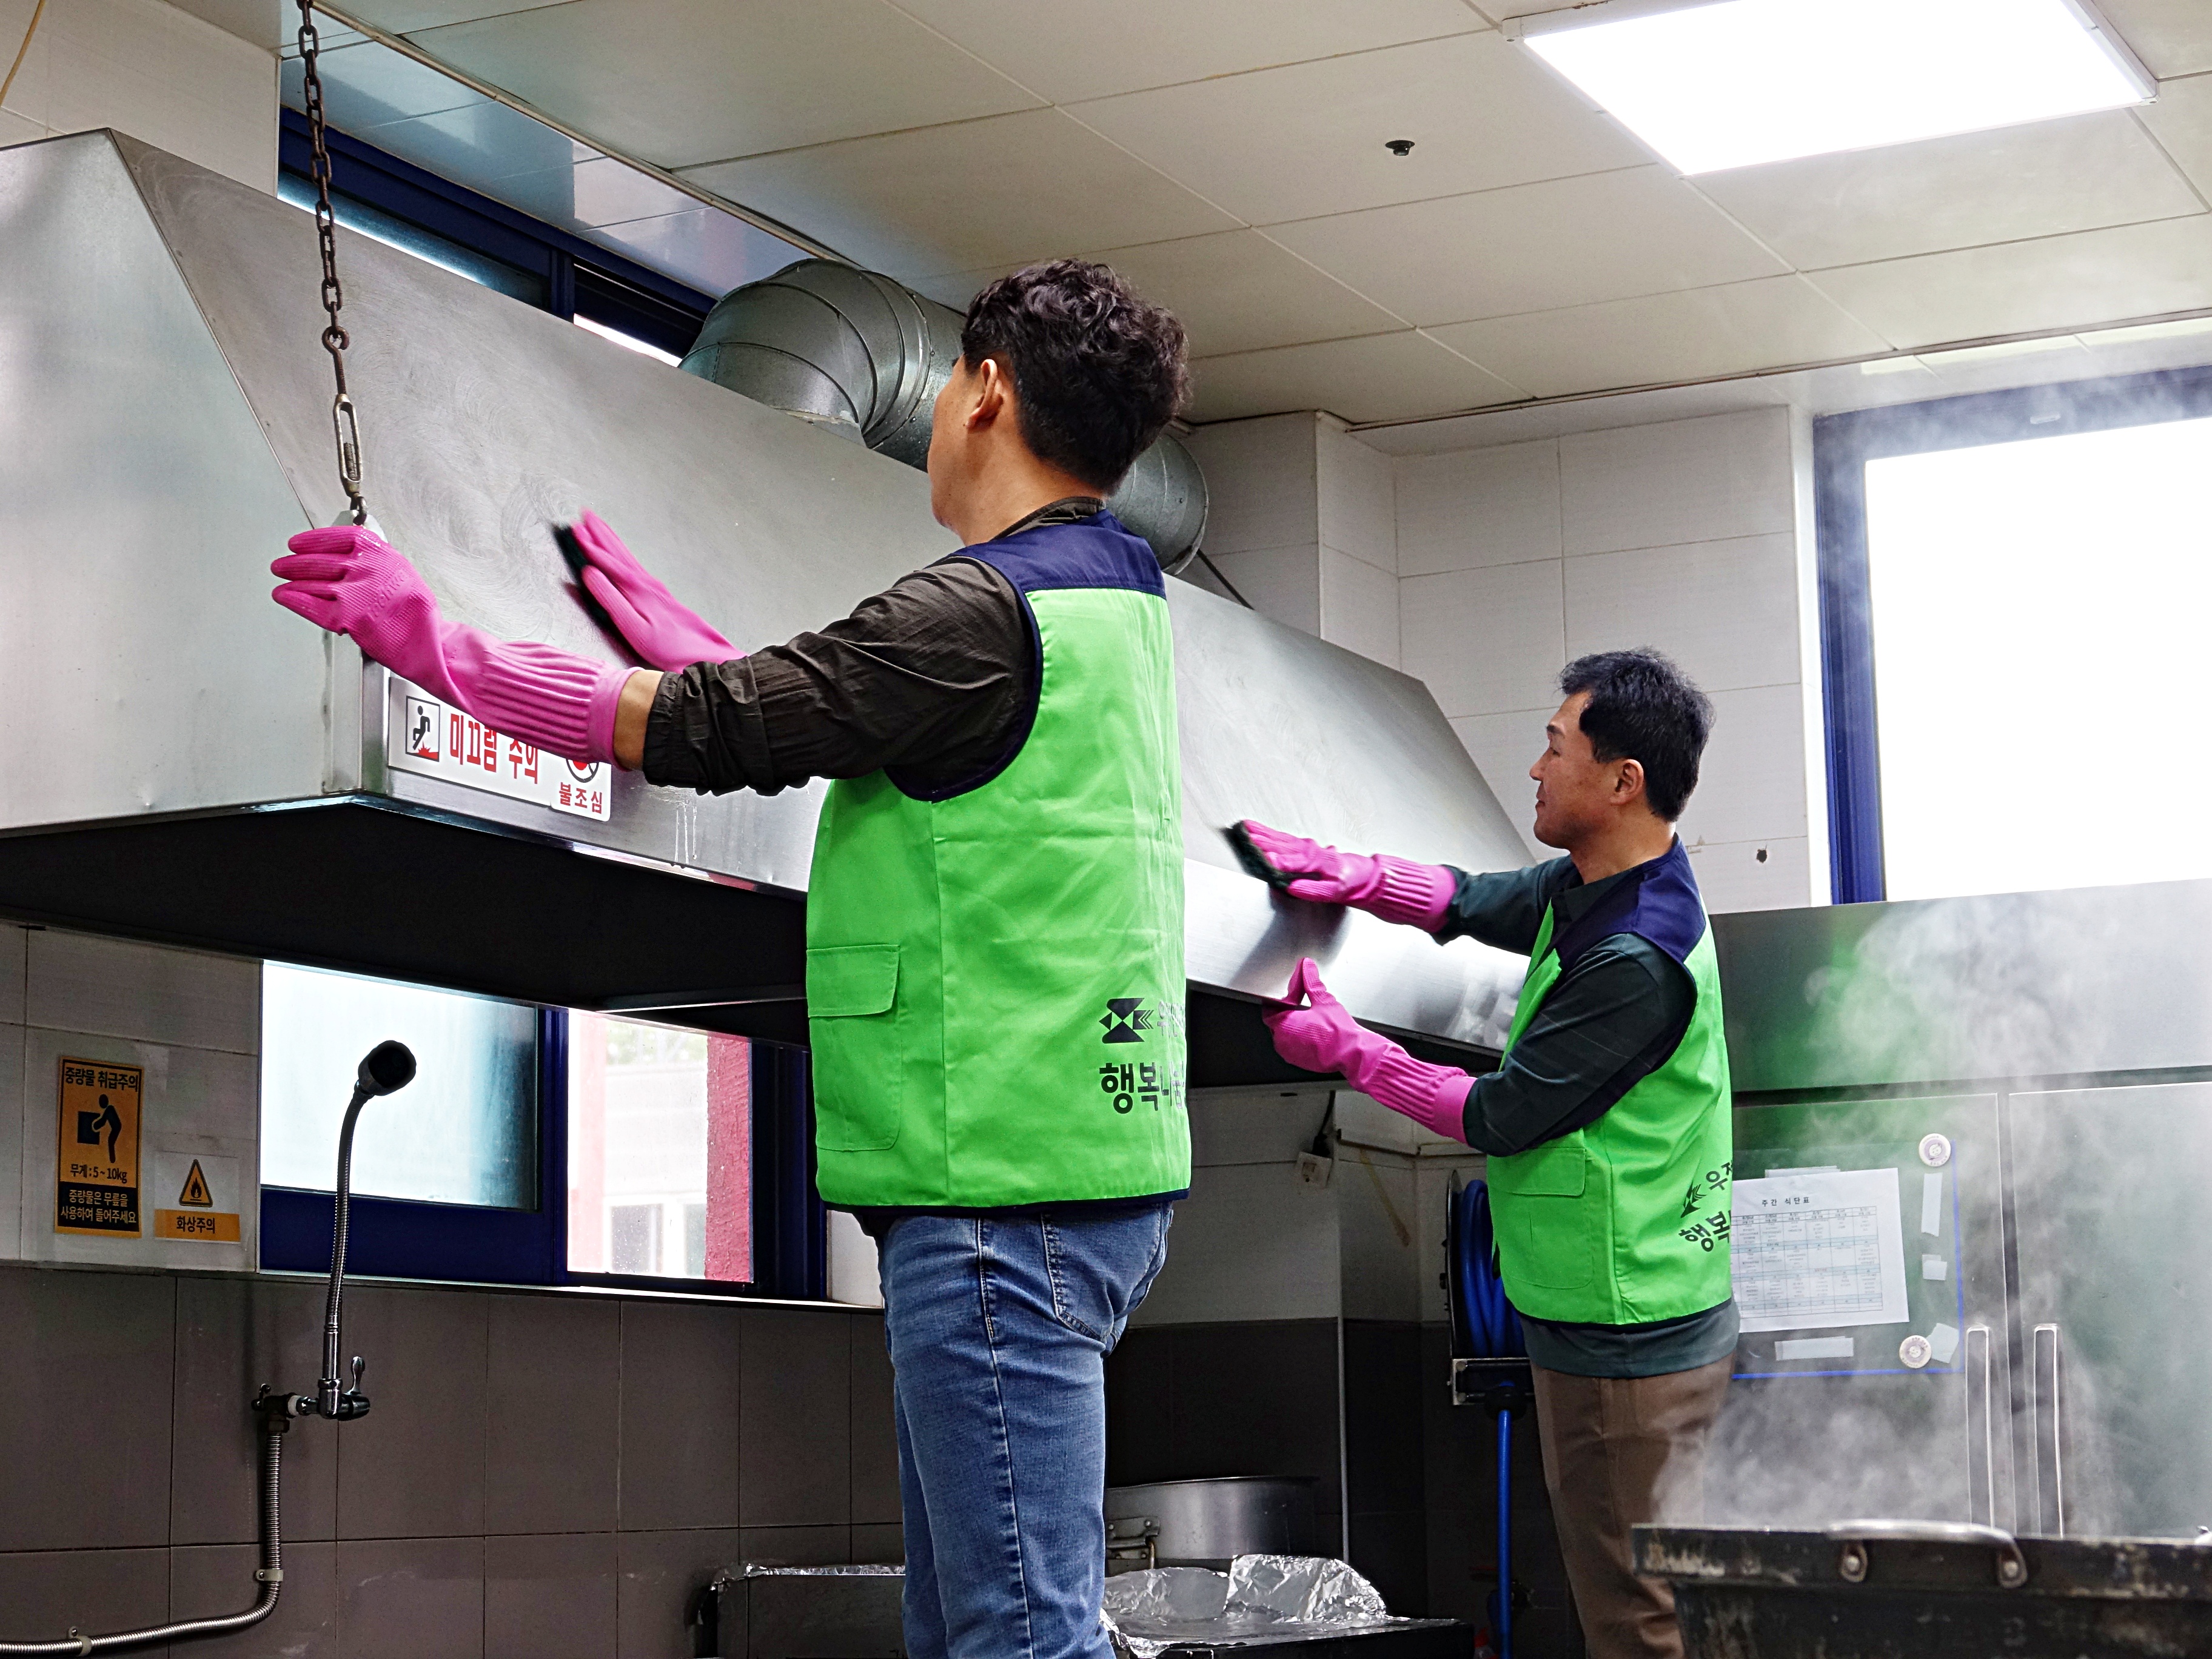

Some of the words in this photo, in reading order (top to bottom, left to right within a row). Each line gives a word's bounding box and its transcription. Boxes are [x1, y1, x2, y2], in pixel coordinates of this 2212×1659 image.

[559, 782, 603, 814] 불조심
[65, 1067, 95, 1086] 중량물
[98, 1071, 138, 1092] 취급주의
[69, 1189, 102, 1205] 중량물은
[104, 1192, 128, 1207] 무릎을
[61, 1205, 93, 1222] 사용하여
[95, 1208, 136, 1224] 들어주세요
[176, 1216, 215, 1234] 화상주의
[1678, 1210, 1732, 1252] 행복
